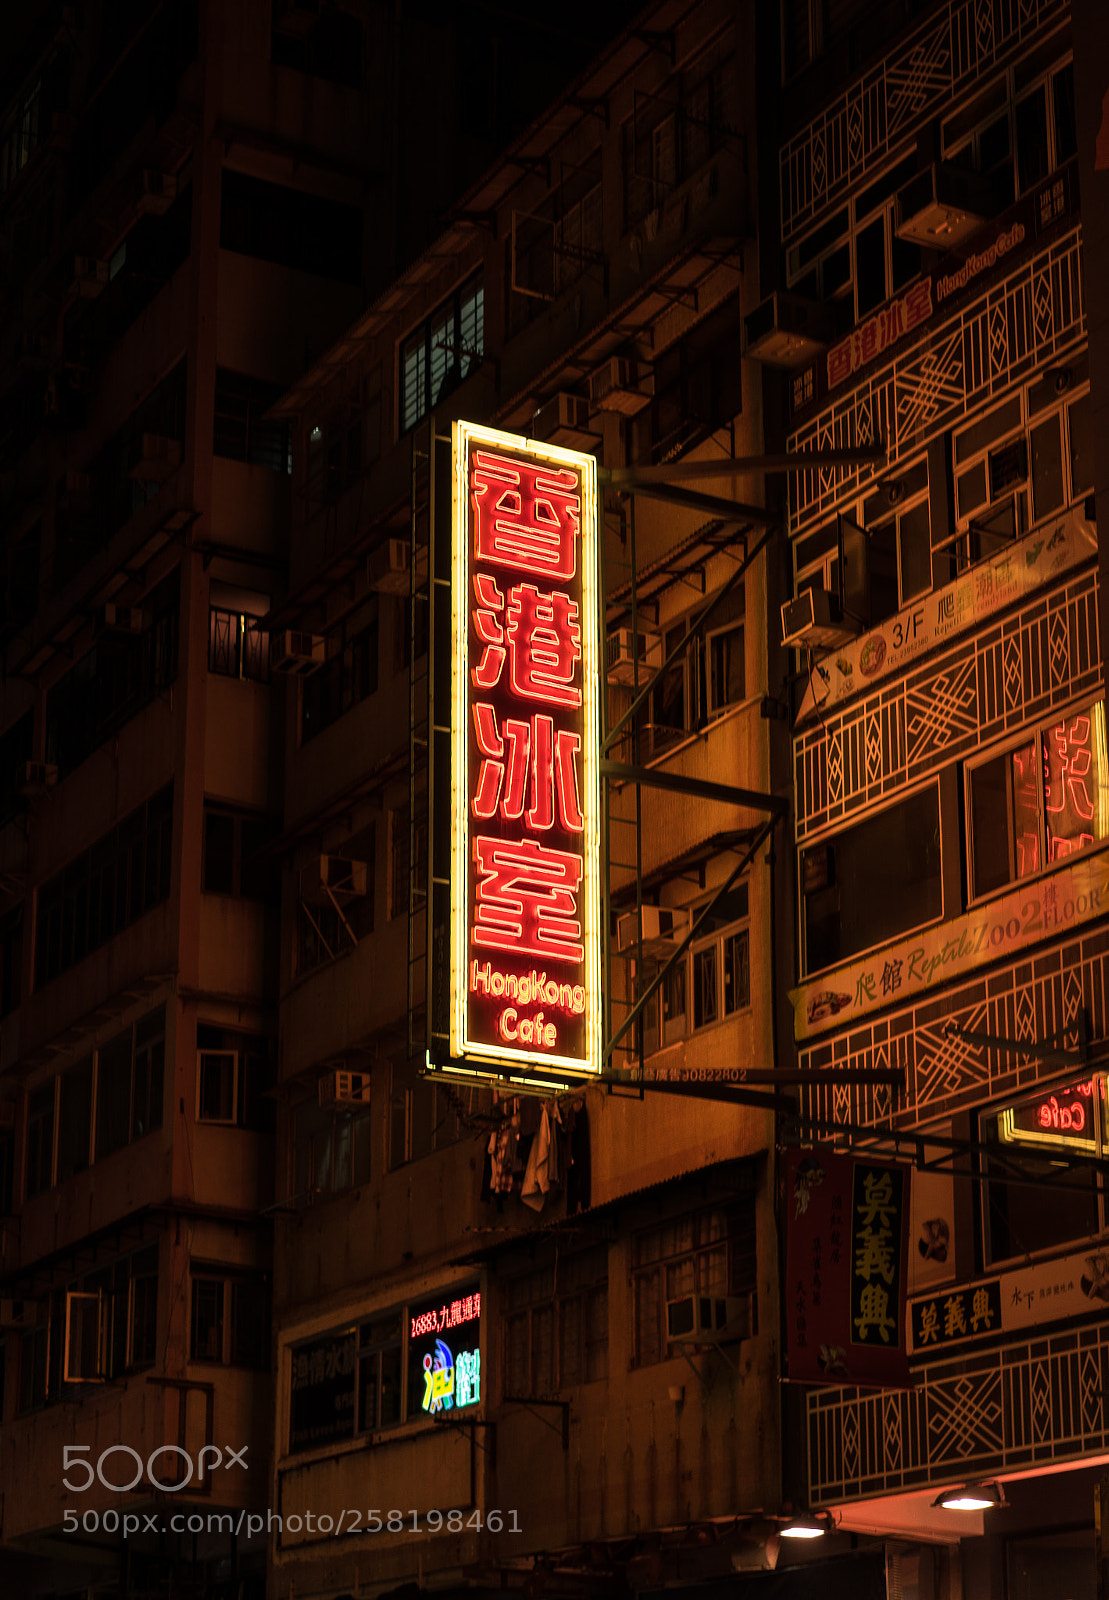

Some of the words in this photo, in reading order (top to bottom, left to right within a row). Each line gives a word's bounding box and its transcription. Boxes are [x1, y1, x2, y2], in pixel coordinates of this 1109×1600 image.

[827, 275, 933, 390] 香港冰室
[892, 609, 925, 649] 3/F
[471, 450, 584, 963] 香港冰室
[1043, 888, 1102, 929] FLOOR
[853, 959, 904, 1008] 爬館
[907, 928, 975, 983] Reptile
[972, 917, 1021, 955] Zoo
[1021, 899, 1043, 936] 2
[471, 960, 586, 1014] HongKong
[499, 1007, 557, 1047] Cafe
